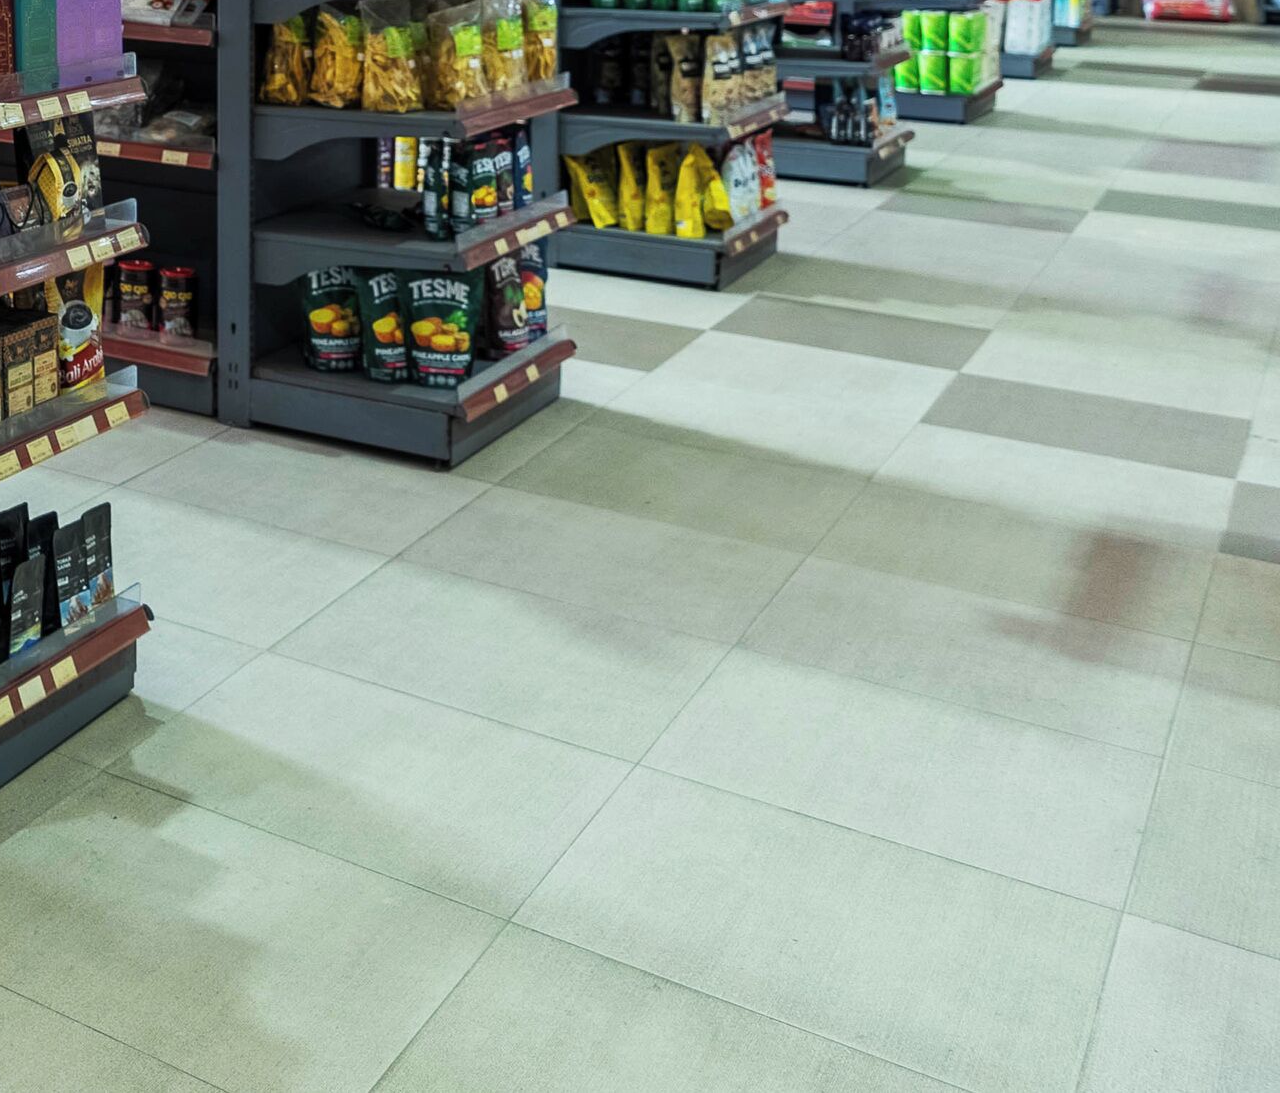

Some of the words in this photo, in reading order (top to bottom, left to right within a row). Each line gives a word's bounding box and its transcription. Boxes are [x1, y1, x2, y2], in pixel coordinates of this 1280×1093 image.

[307, 266, 356, 290] TESM
[368, 272, 397, 298] TES
[408, 277, 472, 304] TESME
[58, 364, 82, 387] Bali
